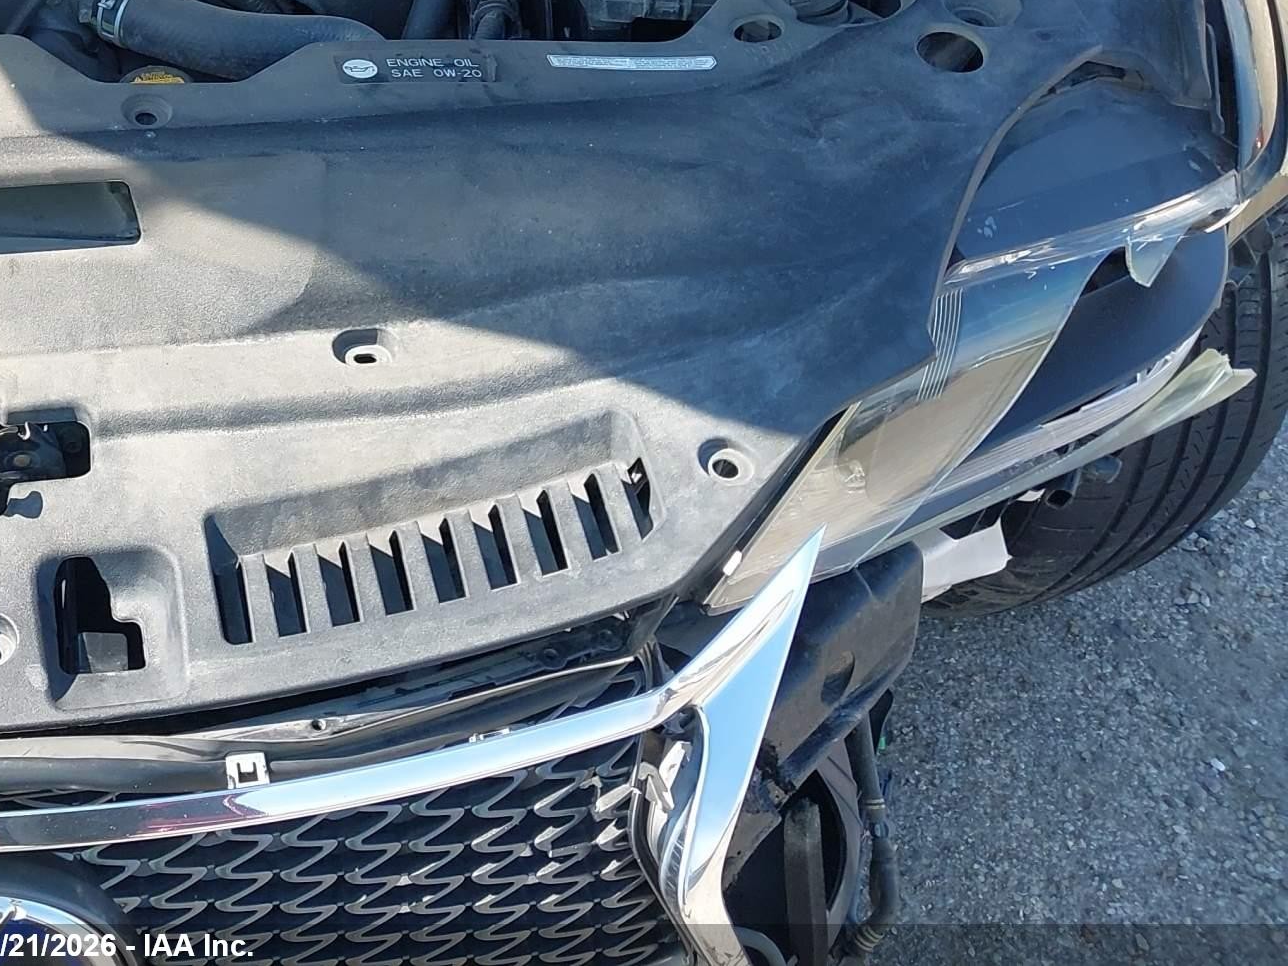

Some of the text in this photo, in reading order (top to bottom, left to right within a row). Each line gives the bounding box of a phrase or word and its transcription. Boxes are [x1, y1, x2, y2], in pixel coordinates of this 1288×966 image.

[386, 58, 479, 67] ENGINE OIL
[391, 68, 482, 78] SAE 0W-20
